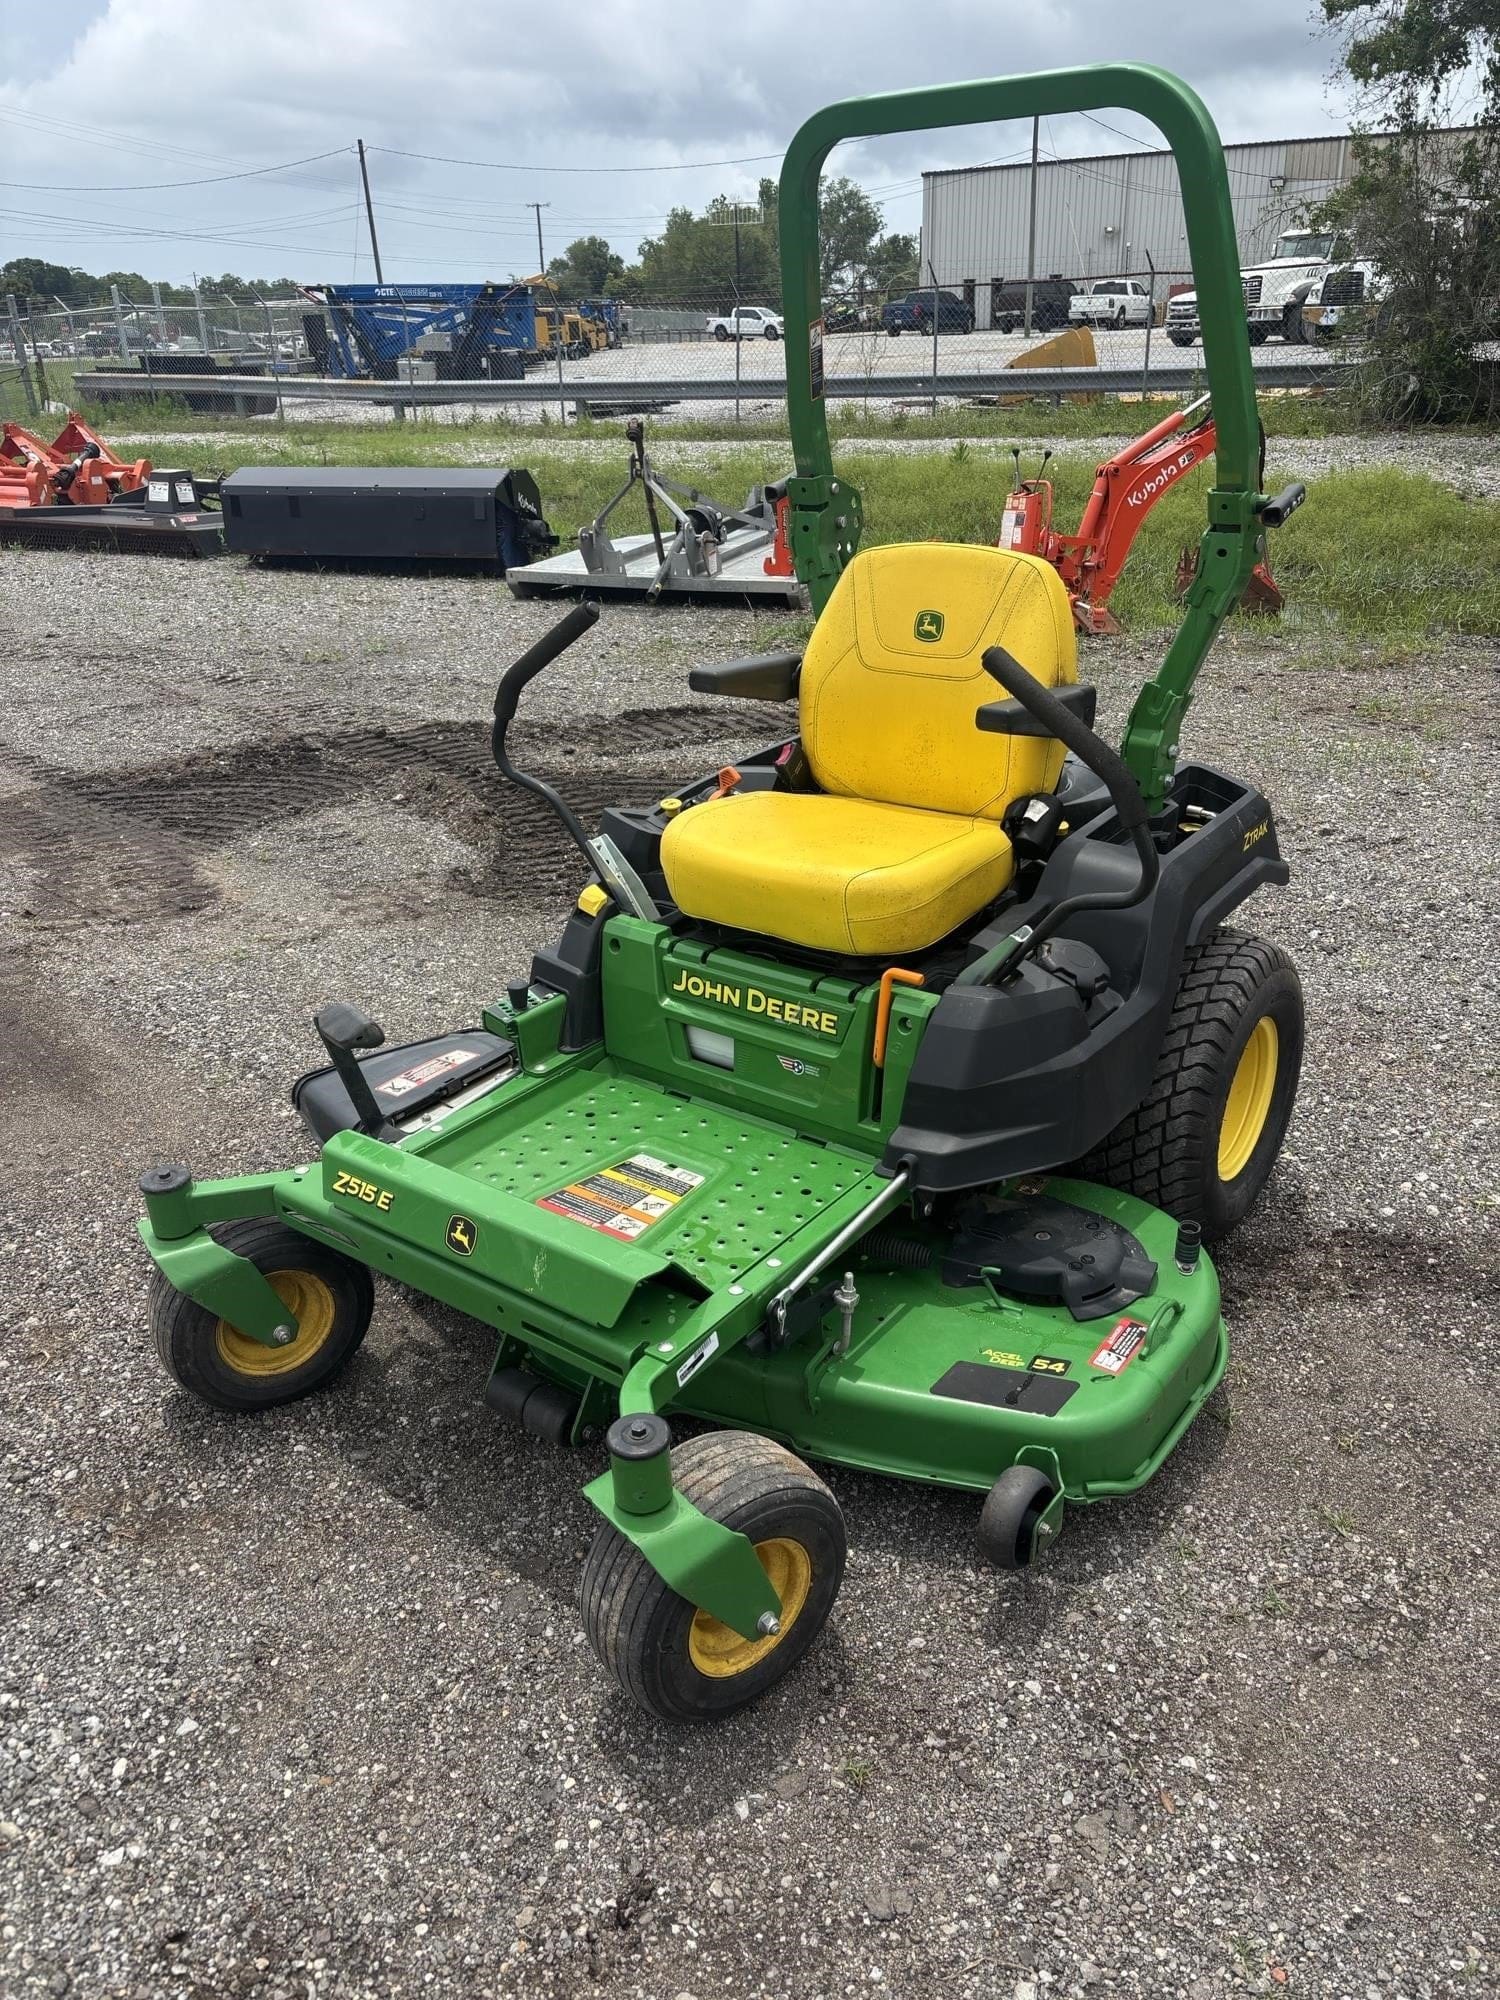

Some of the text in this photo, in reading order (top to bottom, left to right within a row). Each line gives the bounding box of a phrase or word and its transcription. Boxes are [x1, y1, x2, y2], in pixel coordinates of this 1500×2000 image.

[1127, 464, 1177, 507] Kubota
[672, 969, 839, 1036] JOHN DEERE
[332, 1170, 394, 1212] Z515 E
[982, 1348, 1024, 1362] ACCEL
[988, 1356, 1026, 1368] DEEP
[1031, 1358, 1066, 1374] 54
